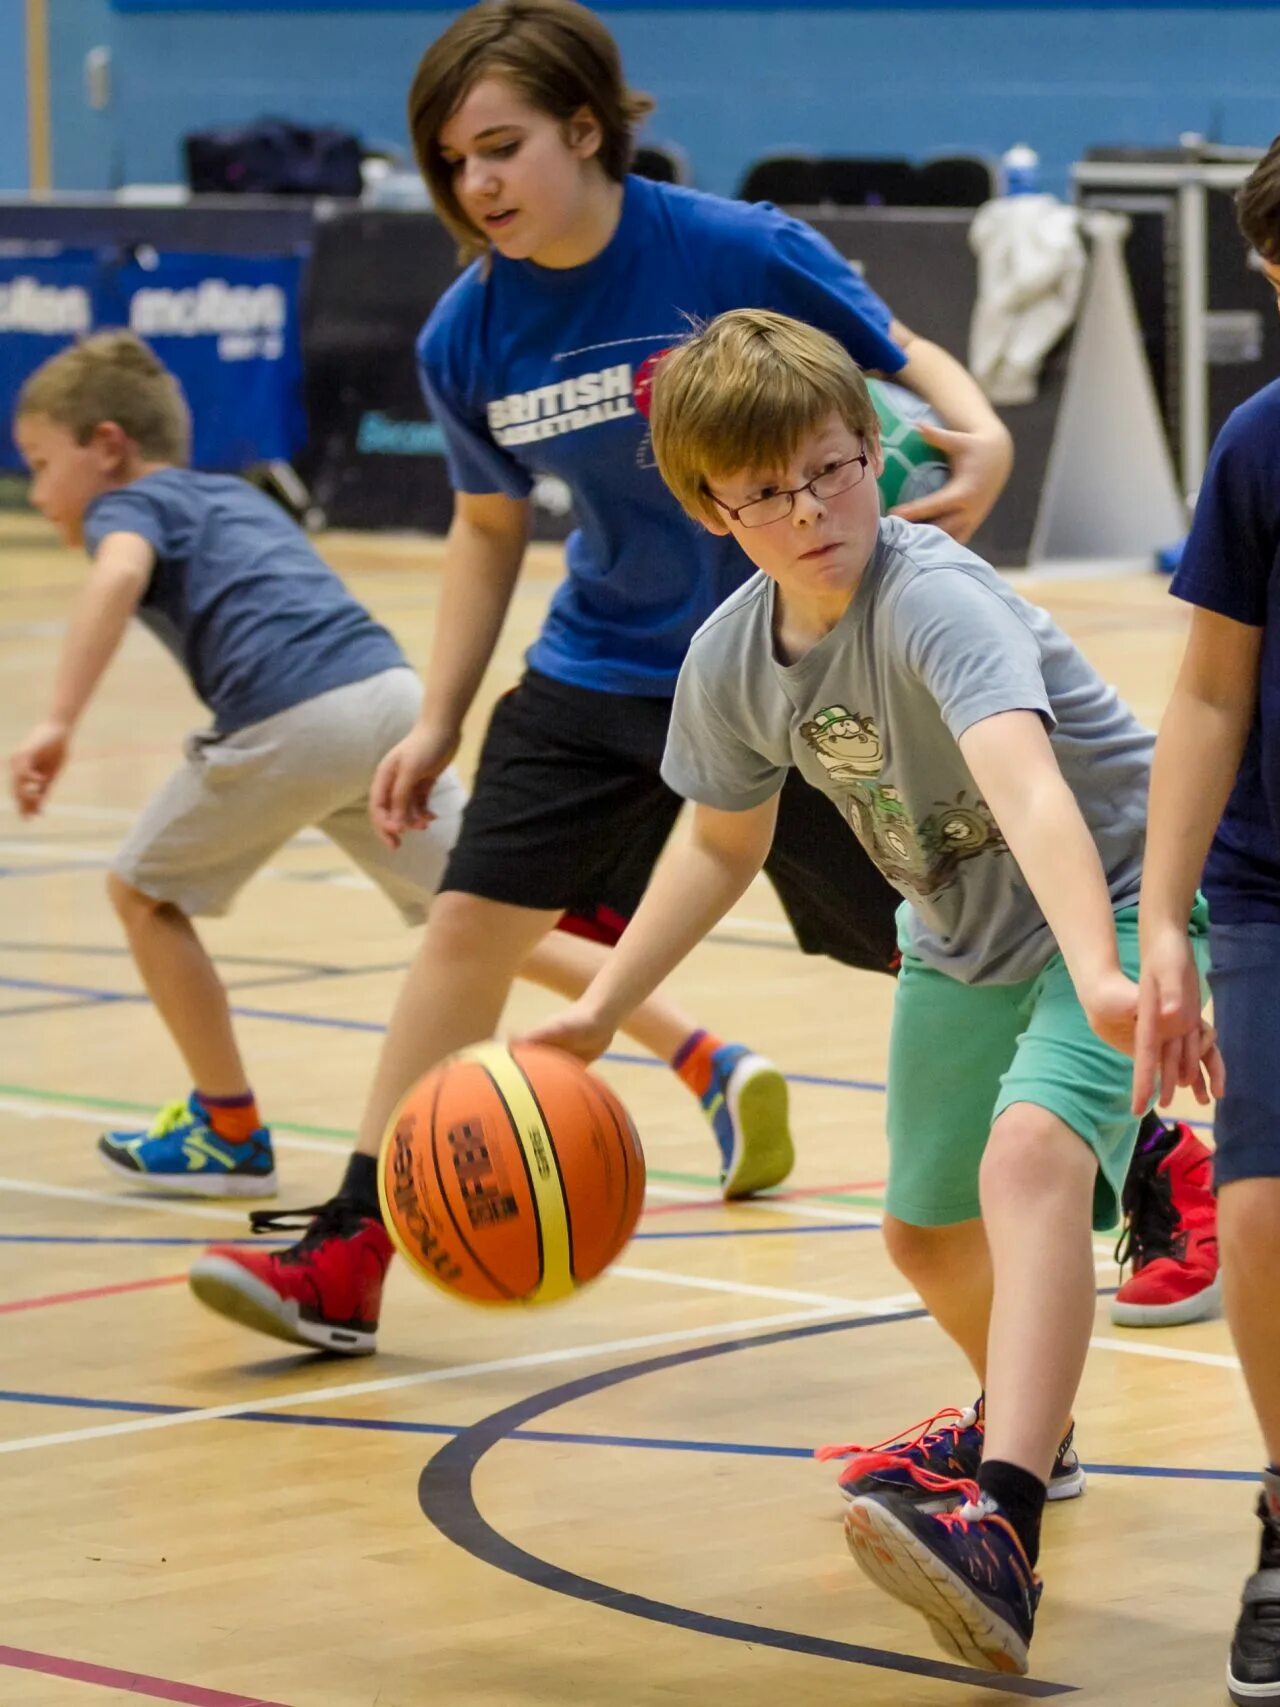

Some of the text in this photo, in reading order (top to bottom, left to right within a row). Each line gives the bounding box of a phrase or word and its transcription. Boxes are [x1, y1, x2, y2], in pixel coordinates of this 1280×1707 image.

[487, 363, 632, 430] BRITISH
[490, 397, 637, 446] BASKETBALL
[392, 1114, 463, 1279] molten
